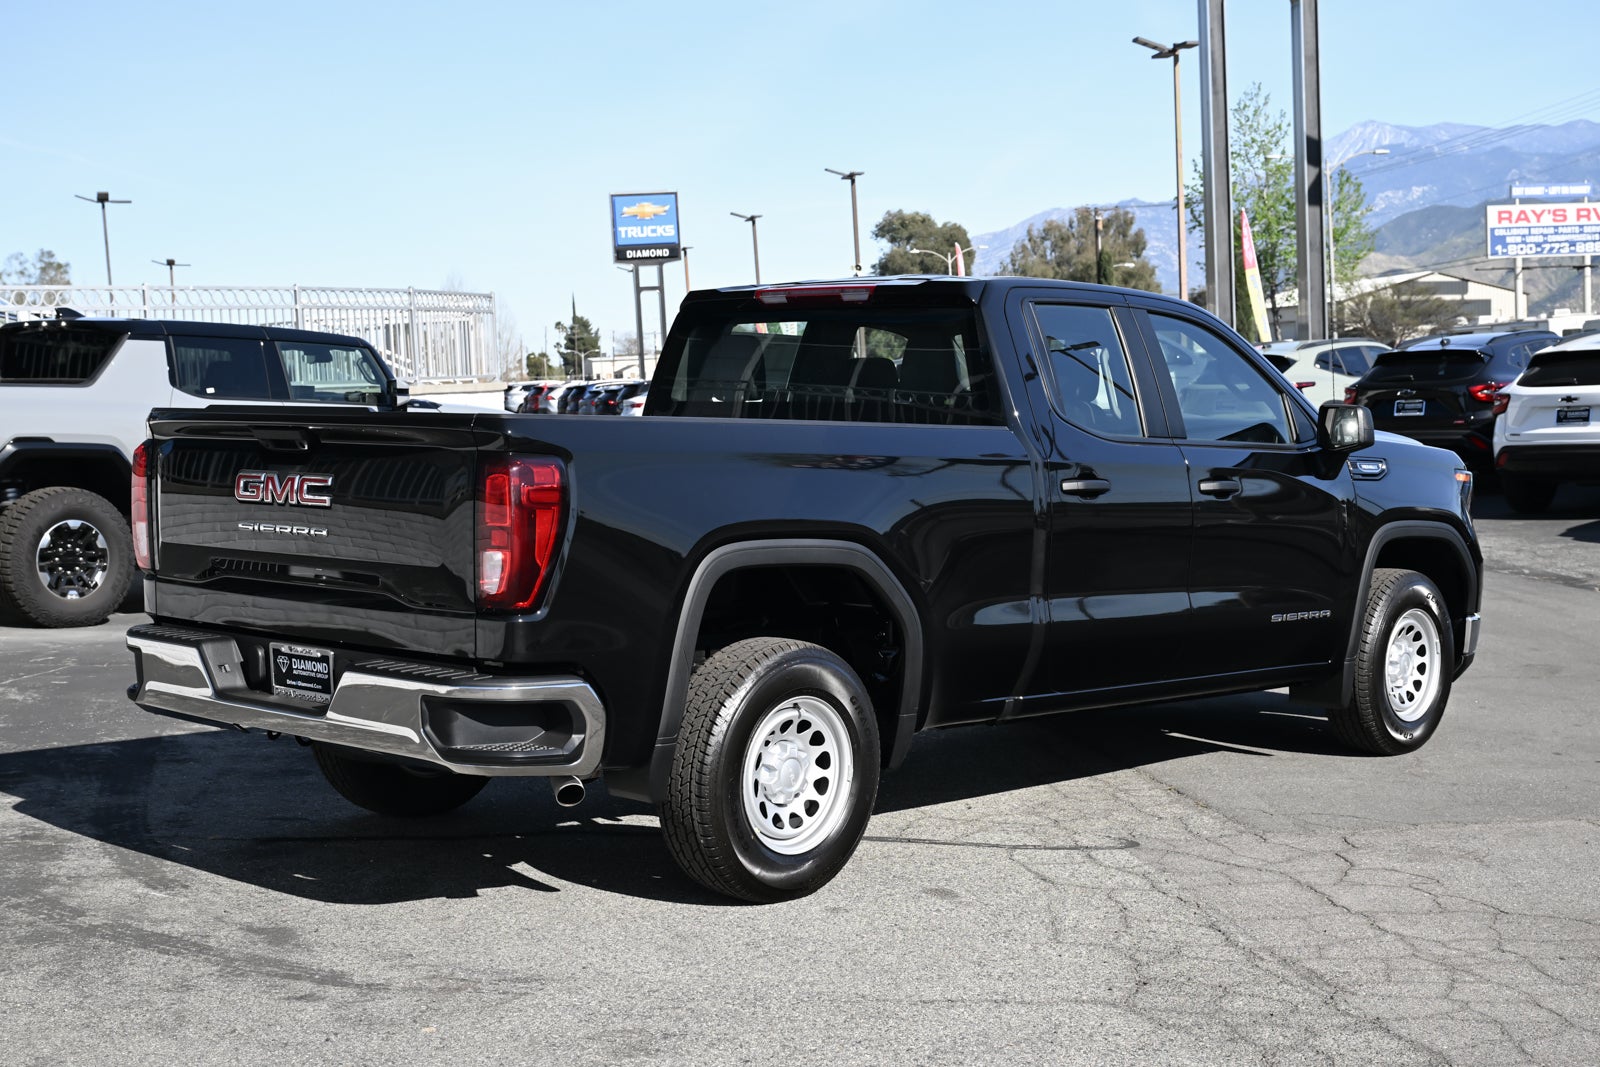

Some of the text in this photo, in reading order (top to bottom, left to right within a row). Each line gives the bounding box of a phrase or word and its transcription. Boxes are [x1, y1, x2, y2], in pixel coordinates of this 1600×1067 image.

[1497, 208, 1568, 224] RAY'S
[618, 225, 675, 238] TRUCKS
[626, 248, 670, 258] DIAMOND
[235, 472, 332, 507] GMC
[238, 522, 328, 537] SIERRA
[1271, 609, 1331, 622] SIERRA
[291, 658, 328, 674] DIAMOND
